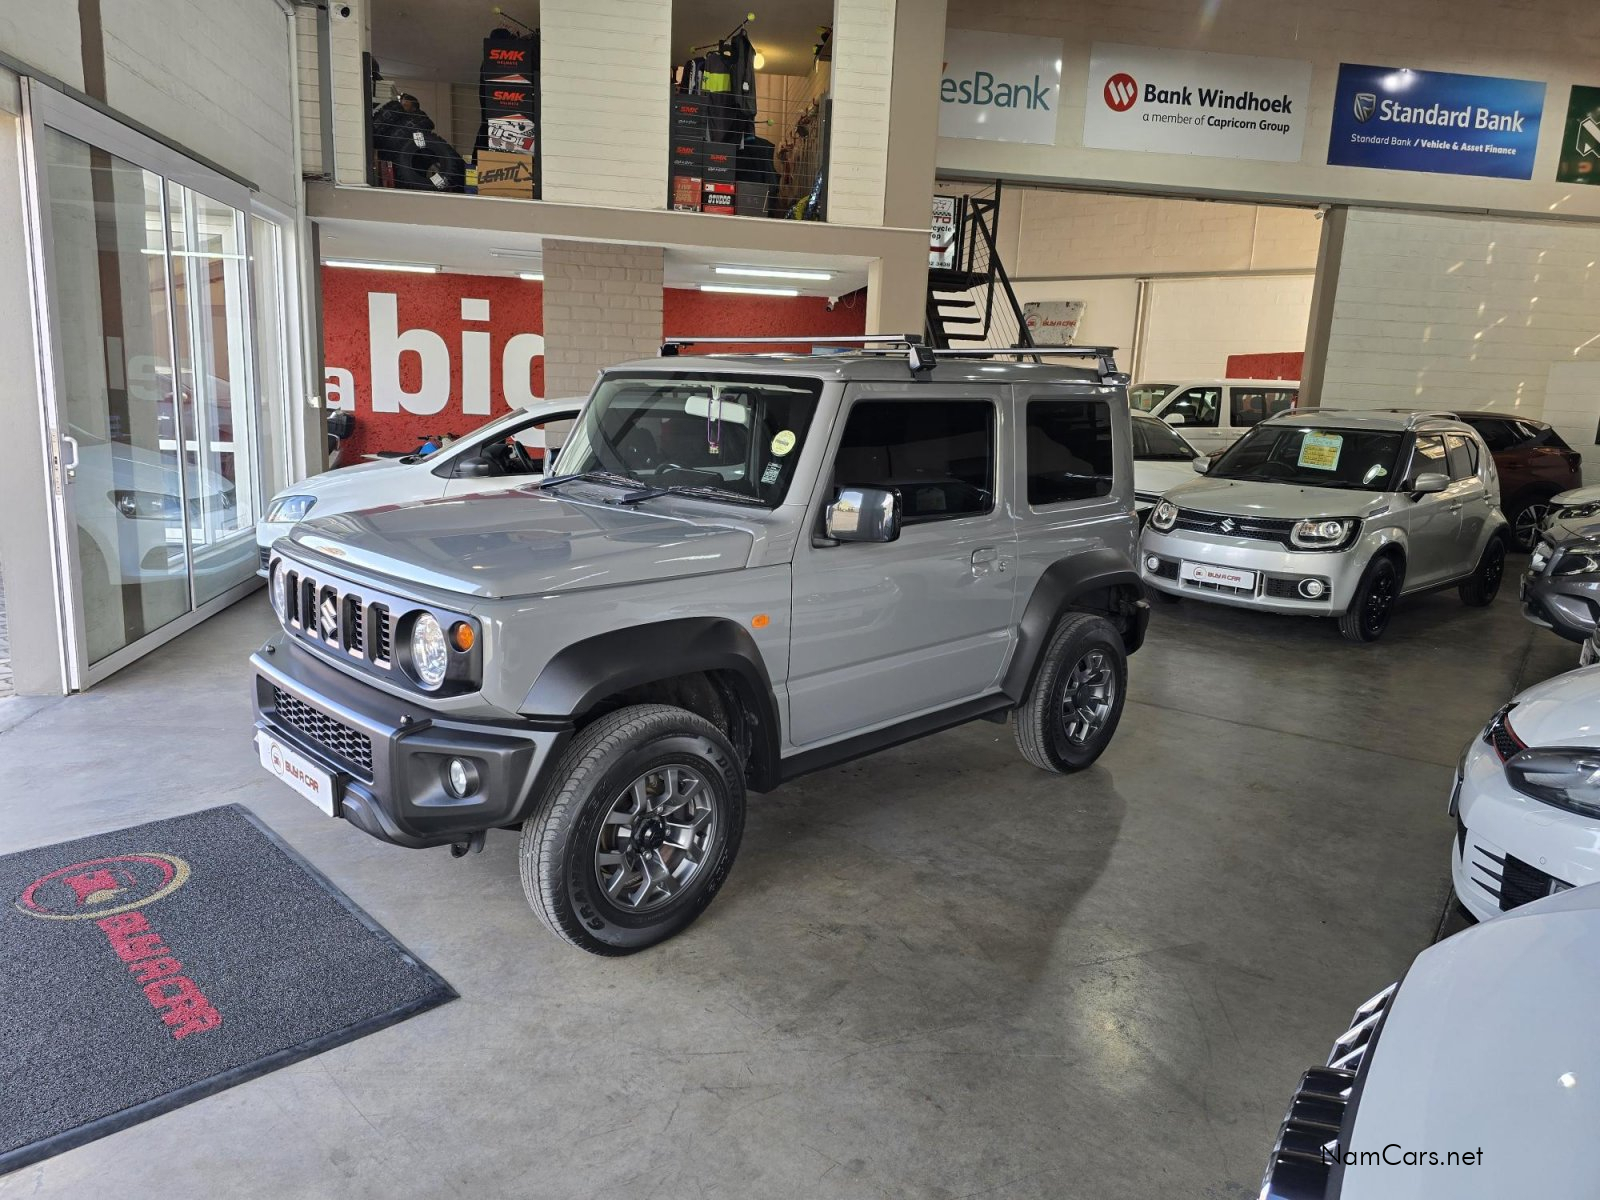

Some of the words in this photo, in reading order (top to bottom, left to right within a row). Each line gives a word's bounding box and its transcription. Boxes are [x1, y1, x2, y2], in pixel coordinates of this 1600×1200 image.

[489, 49, 526, 61] SMK
[493, 90, 526, 102] SMK
[940, 69, 1050, 111] esBank
[1143, 83, 1193, 106] Bank
[1198, 87, 1293, 114] Windhoek
[1142, 113, 1150, 122] a
[1151, 112, 1193, 125] member
[1194, 115, 1205, 126] of
[1207, 115, 1257, 131] Capricorn
[1259, 119, 1290, 135] Group
[1379, 99, 1472, 129] Standard
[1475, 107, 1526, 133] Bank
[1350, 133, 1390, 145] Standard
[1391, 136, 1412, 147] Bank
[1420, 139, 1451, 150] Vehicle
[1452, 141, 1459, 150] &
[1460, 142, 1484, 153] Asset
[1484, 144, 1517, 155] Finance
[285, 760, 299, 779] BUY
[299, 770, 304, 784] A
[305, 774, 319, 793] CAR
